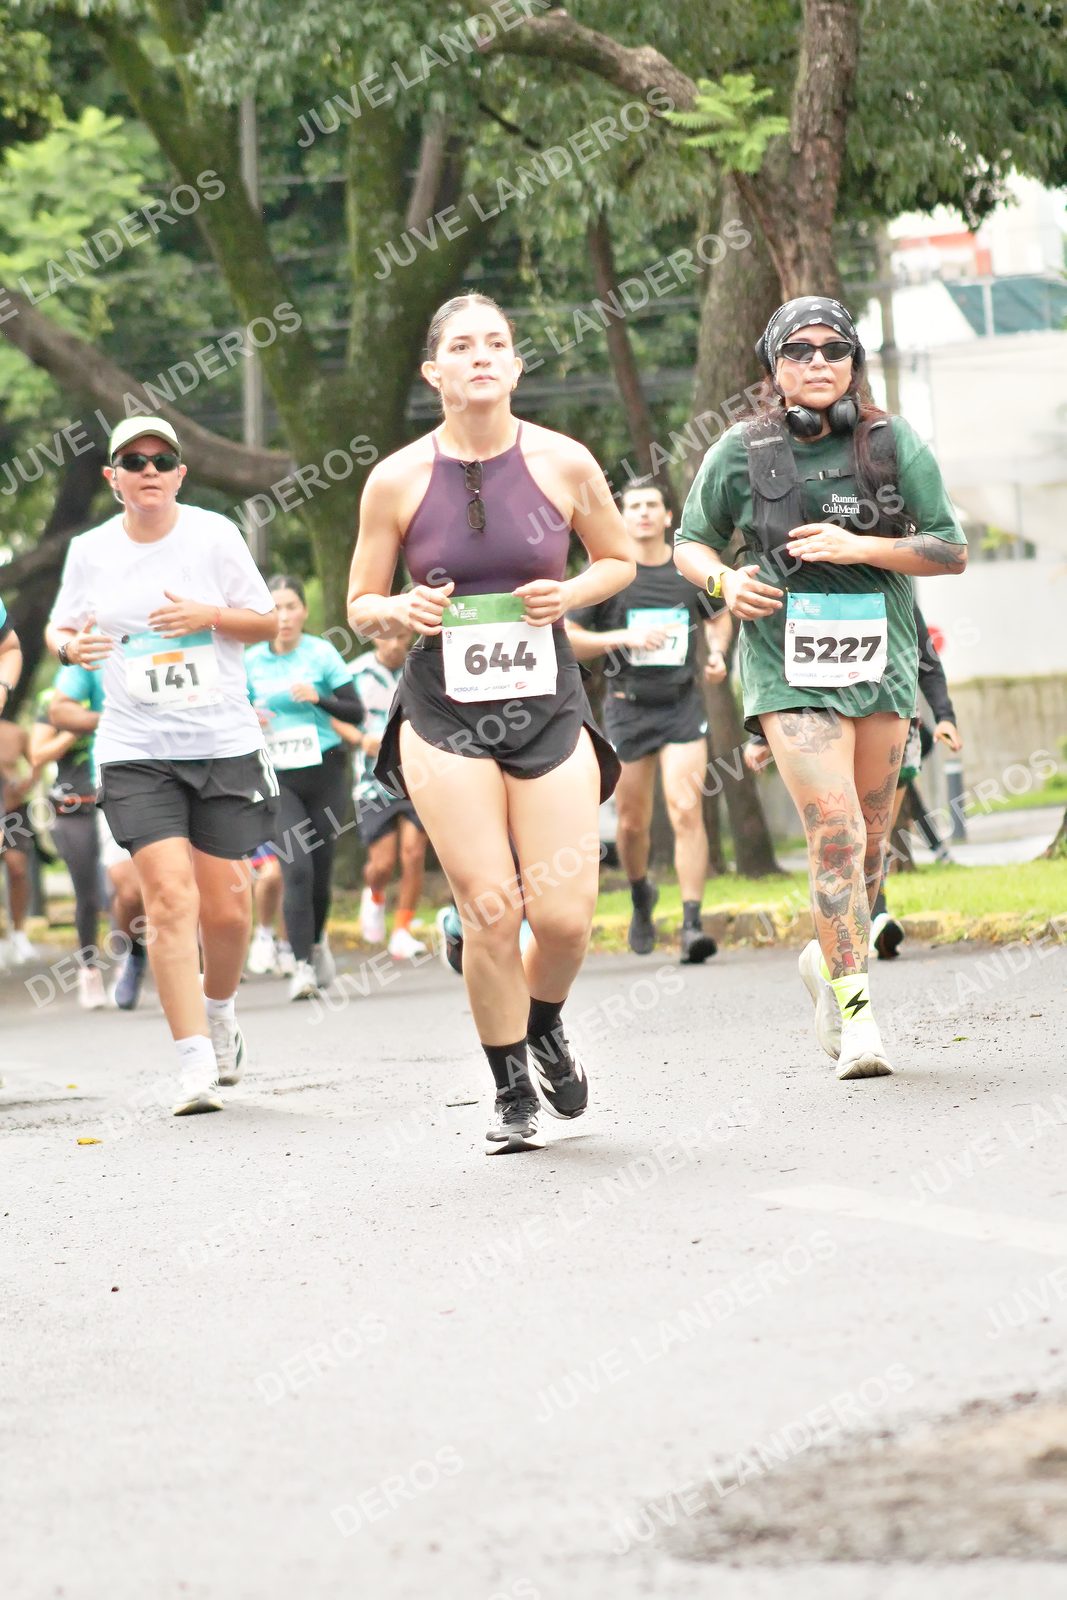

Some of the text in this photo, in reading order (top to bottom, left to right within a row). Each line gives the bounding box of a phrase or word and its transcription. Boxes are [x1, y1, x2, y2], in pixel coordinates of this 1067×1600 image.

[464, 641, 537, 676] 644
[793, 635, 882, 664] 5227
[145, 663, 200, 693] 141
